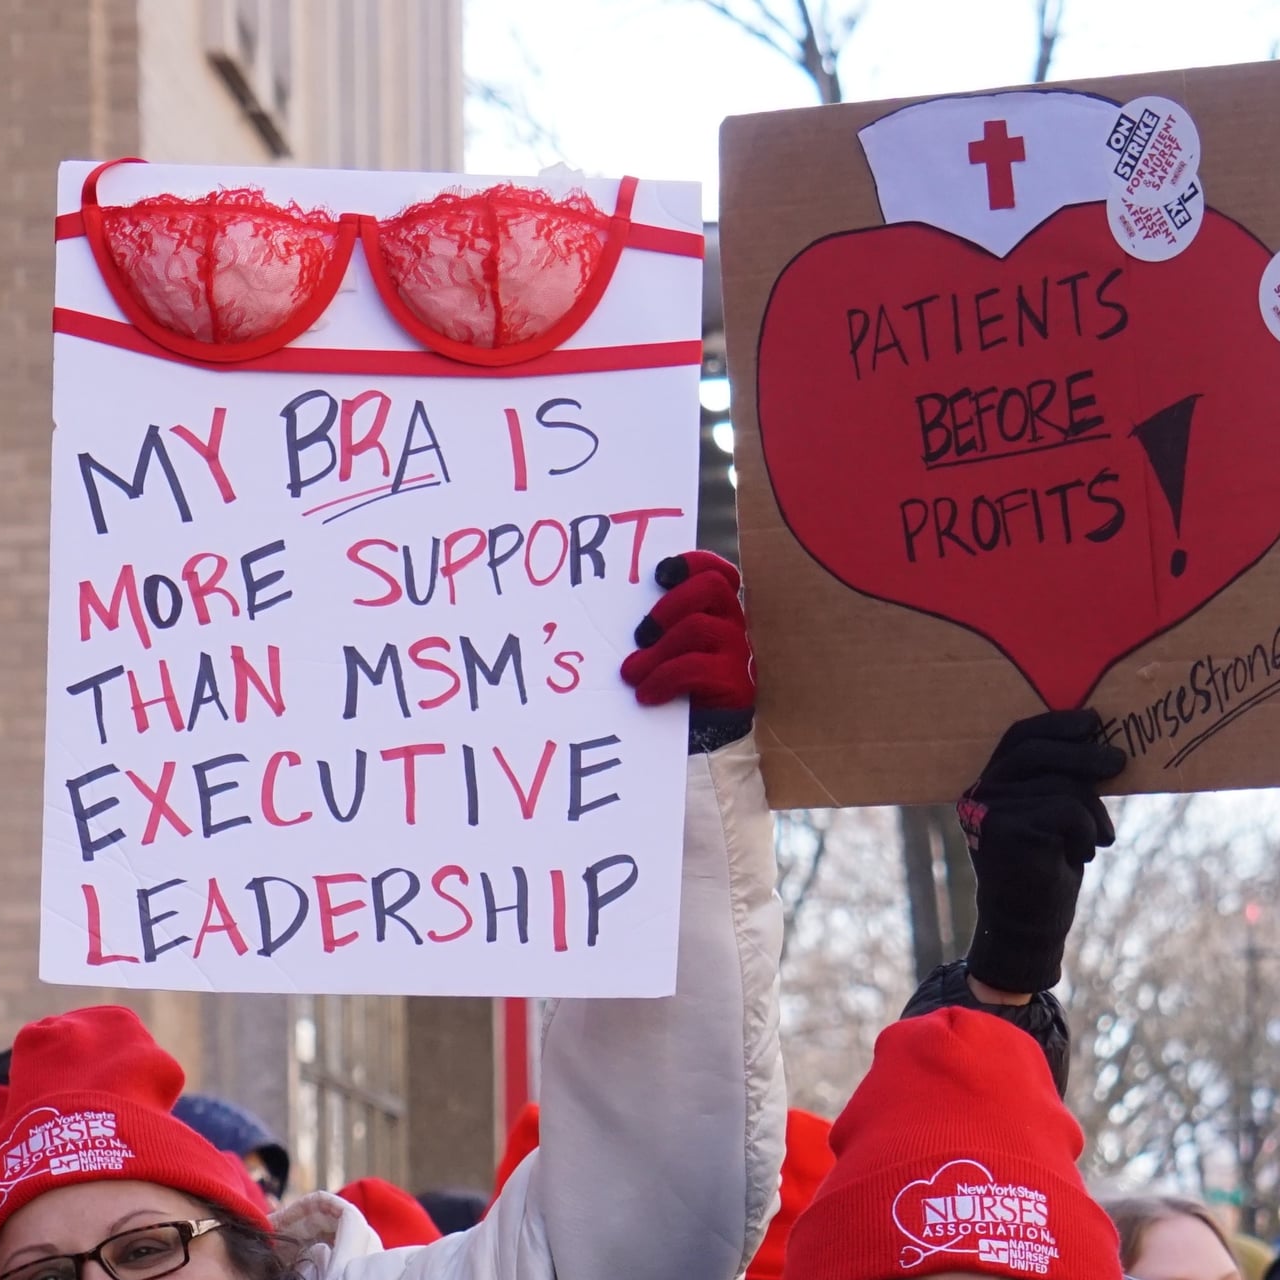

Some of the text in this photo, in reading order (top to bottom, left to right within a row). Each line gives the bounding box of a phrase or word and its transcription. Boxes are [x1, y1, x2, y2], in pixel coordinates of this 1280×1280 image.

[1109, 117, 1134, 150] ON
[1116, 110, 1159, 179] STRIKE
[1126, 169, 1147, 195] FOR
[1142, 114, 1177, 167] PATIENT
[1148, 135, 1178, 178] NURSE
[1152, 145, 1183, 191] SAFETY
[1123, 199, 1152, 242] AFETY
[1139, 205, 1161, 239] URSE
[1150, 205, 1177, 245] TIENT
[847, 268, 1130, 380] PATIENTS
[915, 369, 1105, 462] BEFORE
[77, 389, 599, 534] MY BRA IS
[78, 507, 685, 649] MORE SUPPORT
[66, 645, 287, 744] THAN
[66, 734, 622, 862] EXECUTIVE
[81, 853, 638, 966] LEADERSHIP
[29, 1110, 116, 1137] New York State
[4, 1118, 117, 1173] NURSES
[4, 1138, 122, 1179] ASSOCIATION
[78, 1149, 136, 1160] NATIONAL
[80, 1156, 124, 1166] NURSES
[81, 1162, 123, 1172] UNITED
[922, 1194, 1048, 1228] NURSES
[957, 1183, 1047, 1203] New York State
[922, 1222, 1052, 1243] ASSOCIATION
[1009, 1239, 1059, 1259] NATIONAL
[1010, 1251, 1050, 1265] NURSES
[1010, 1260, 1049, 1274] UNITED
